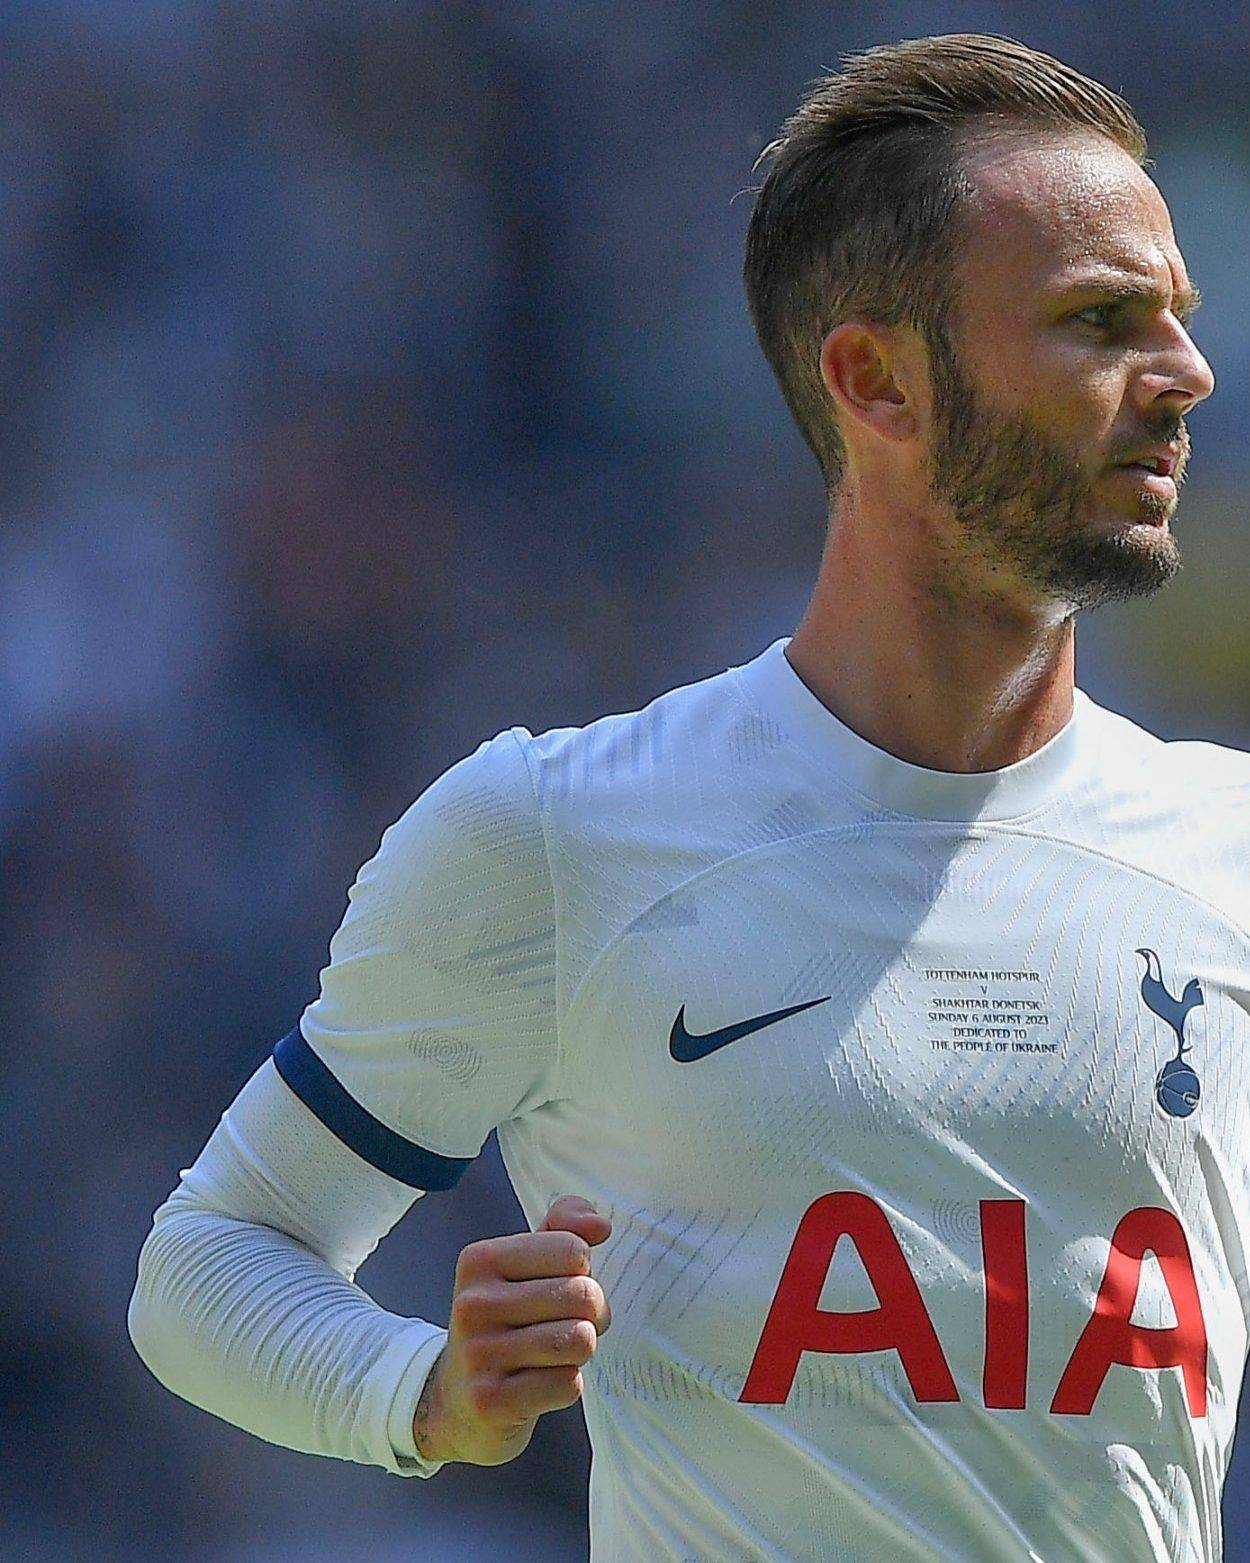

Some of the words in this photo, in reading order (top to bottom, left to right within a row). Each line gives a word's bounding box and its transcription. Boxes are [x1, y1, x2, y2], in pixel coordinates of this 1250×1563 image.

[924, 971, 988, 981] TOTTENHAM
[991, 972, 1040, 982] HOTSPUR
[932, 998, 989, 1009] SHAKHTAR
[992, 1000, 1040, 1010] DONETSK
[928, 1012, 968, 1023] SUNDAY
[972, 1014, 978, 1023] 6
[983, 1014, 1021, 1024] AUGUST
[1025, 1015, 1048, 1025] 2023
[953, 1028, 1010, 1038] DEDICATED
[1014, 1029, 1026, 1038] TO
[931, 1041, 948, 1050] THE
[953, 1042, 990, 1052] PEOPLE
[995, 1043, 1008, 1052] OF
[1012, 1044, 1059, 1054] UKRAINE
[738, 1190, 1208, 1418] AIA
